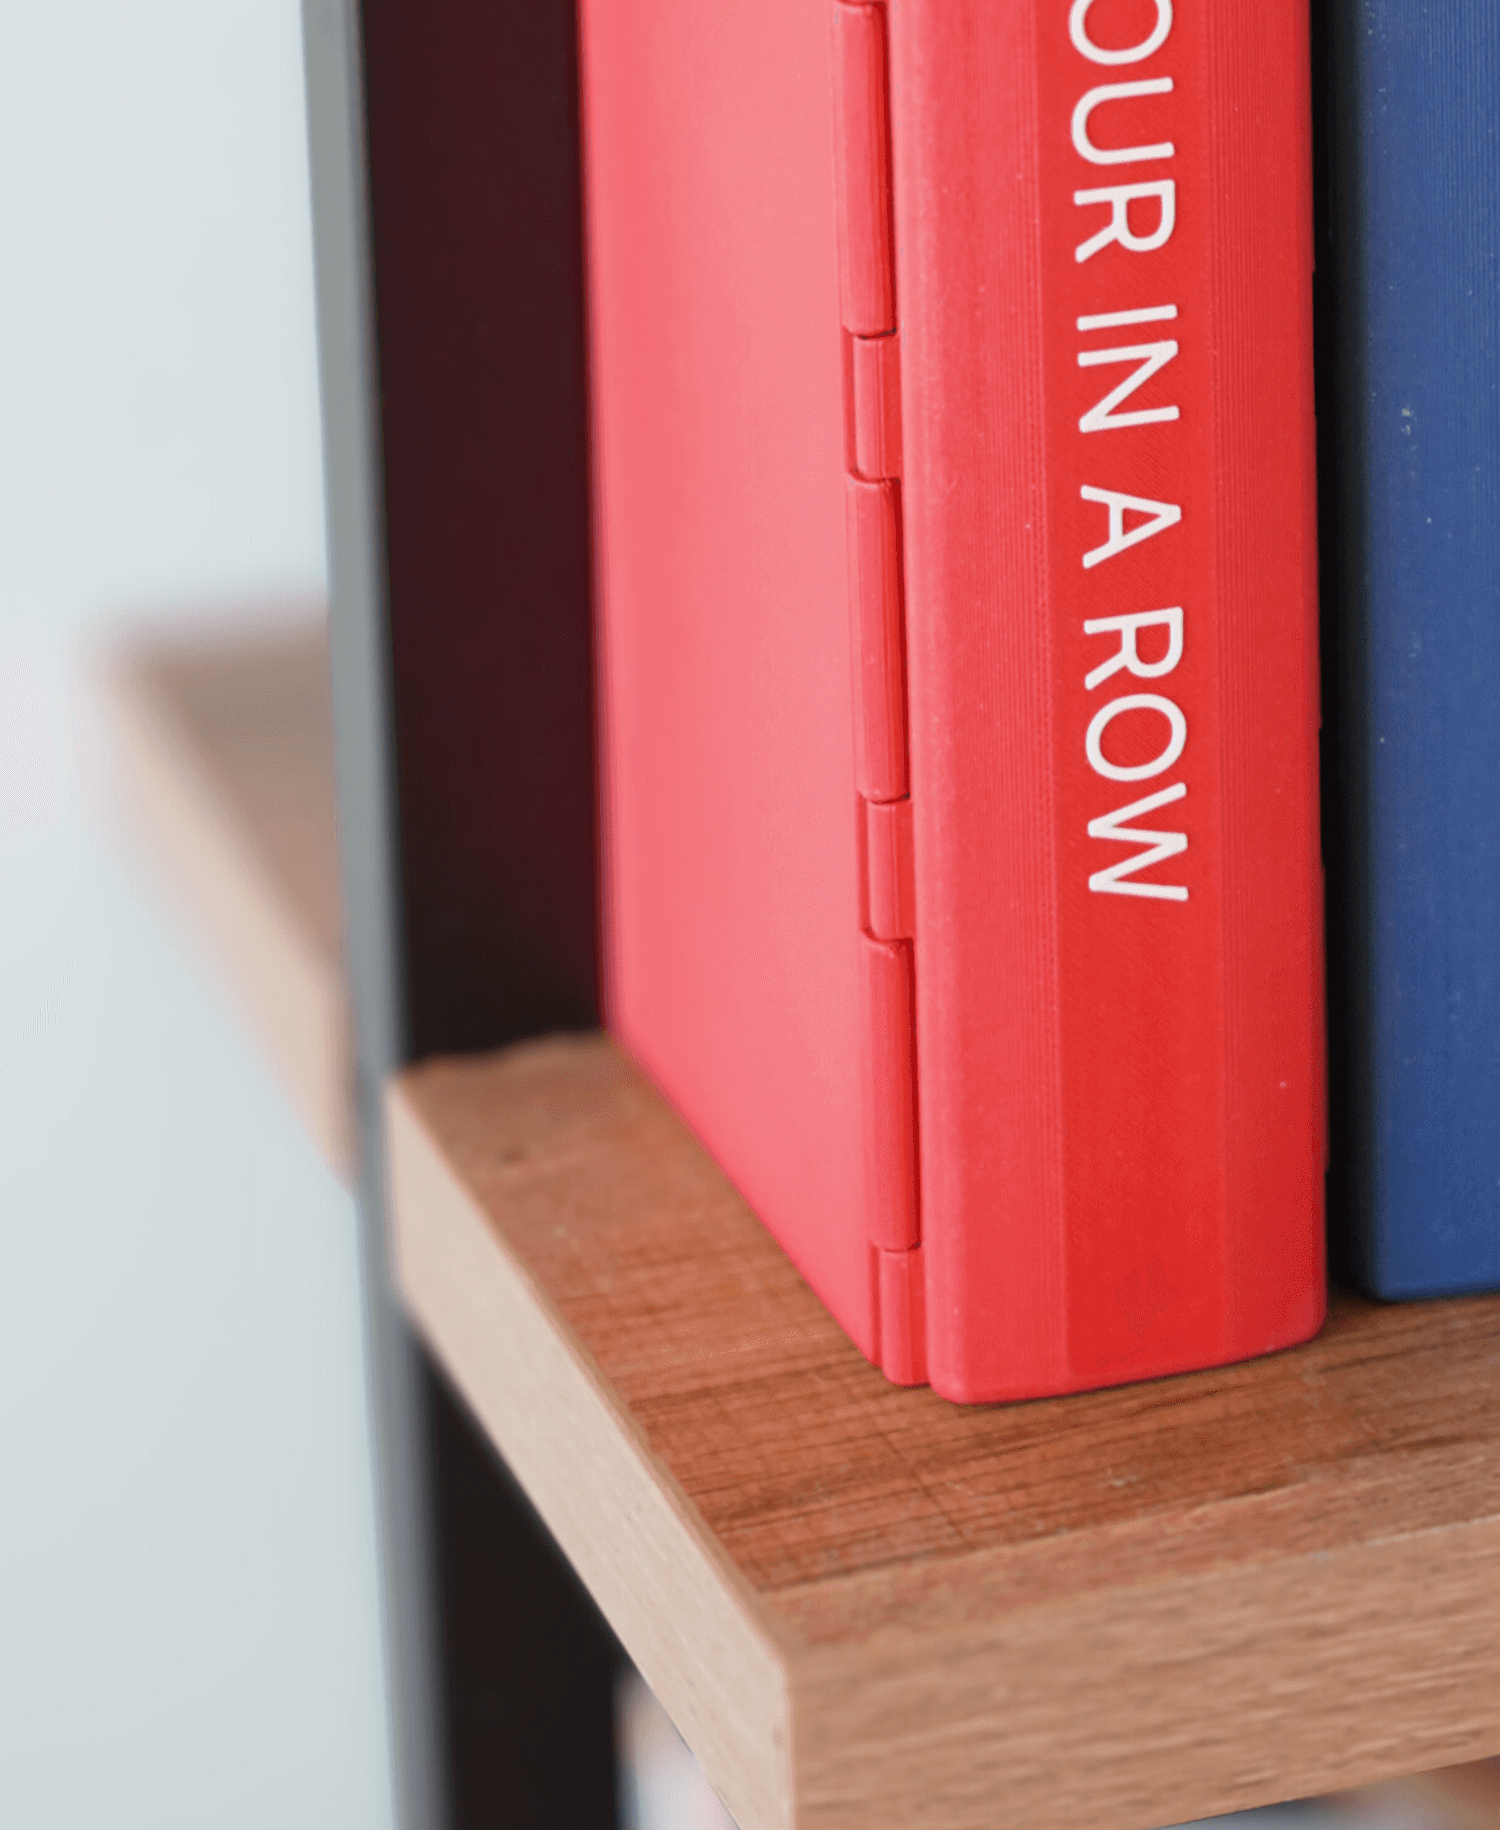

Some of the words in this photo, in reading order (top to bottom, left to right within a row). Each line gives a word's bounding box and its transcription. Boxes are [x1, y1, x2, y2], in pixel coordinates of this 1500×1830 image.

[1074, 302, 1181, 435] IN
[1078, 483, 1184, 571] A
[1081, 604, 1191, 903] ROW
